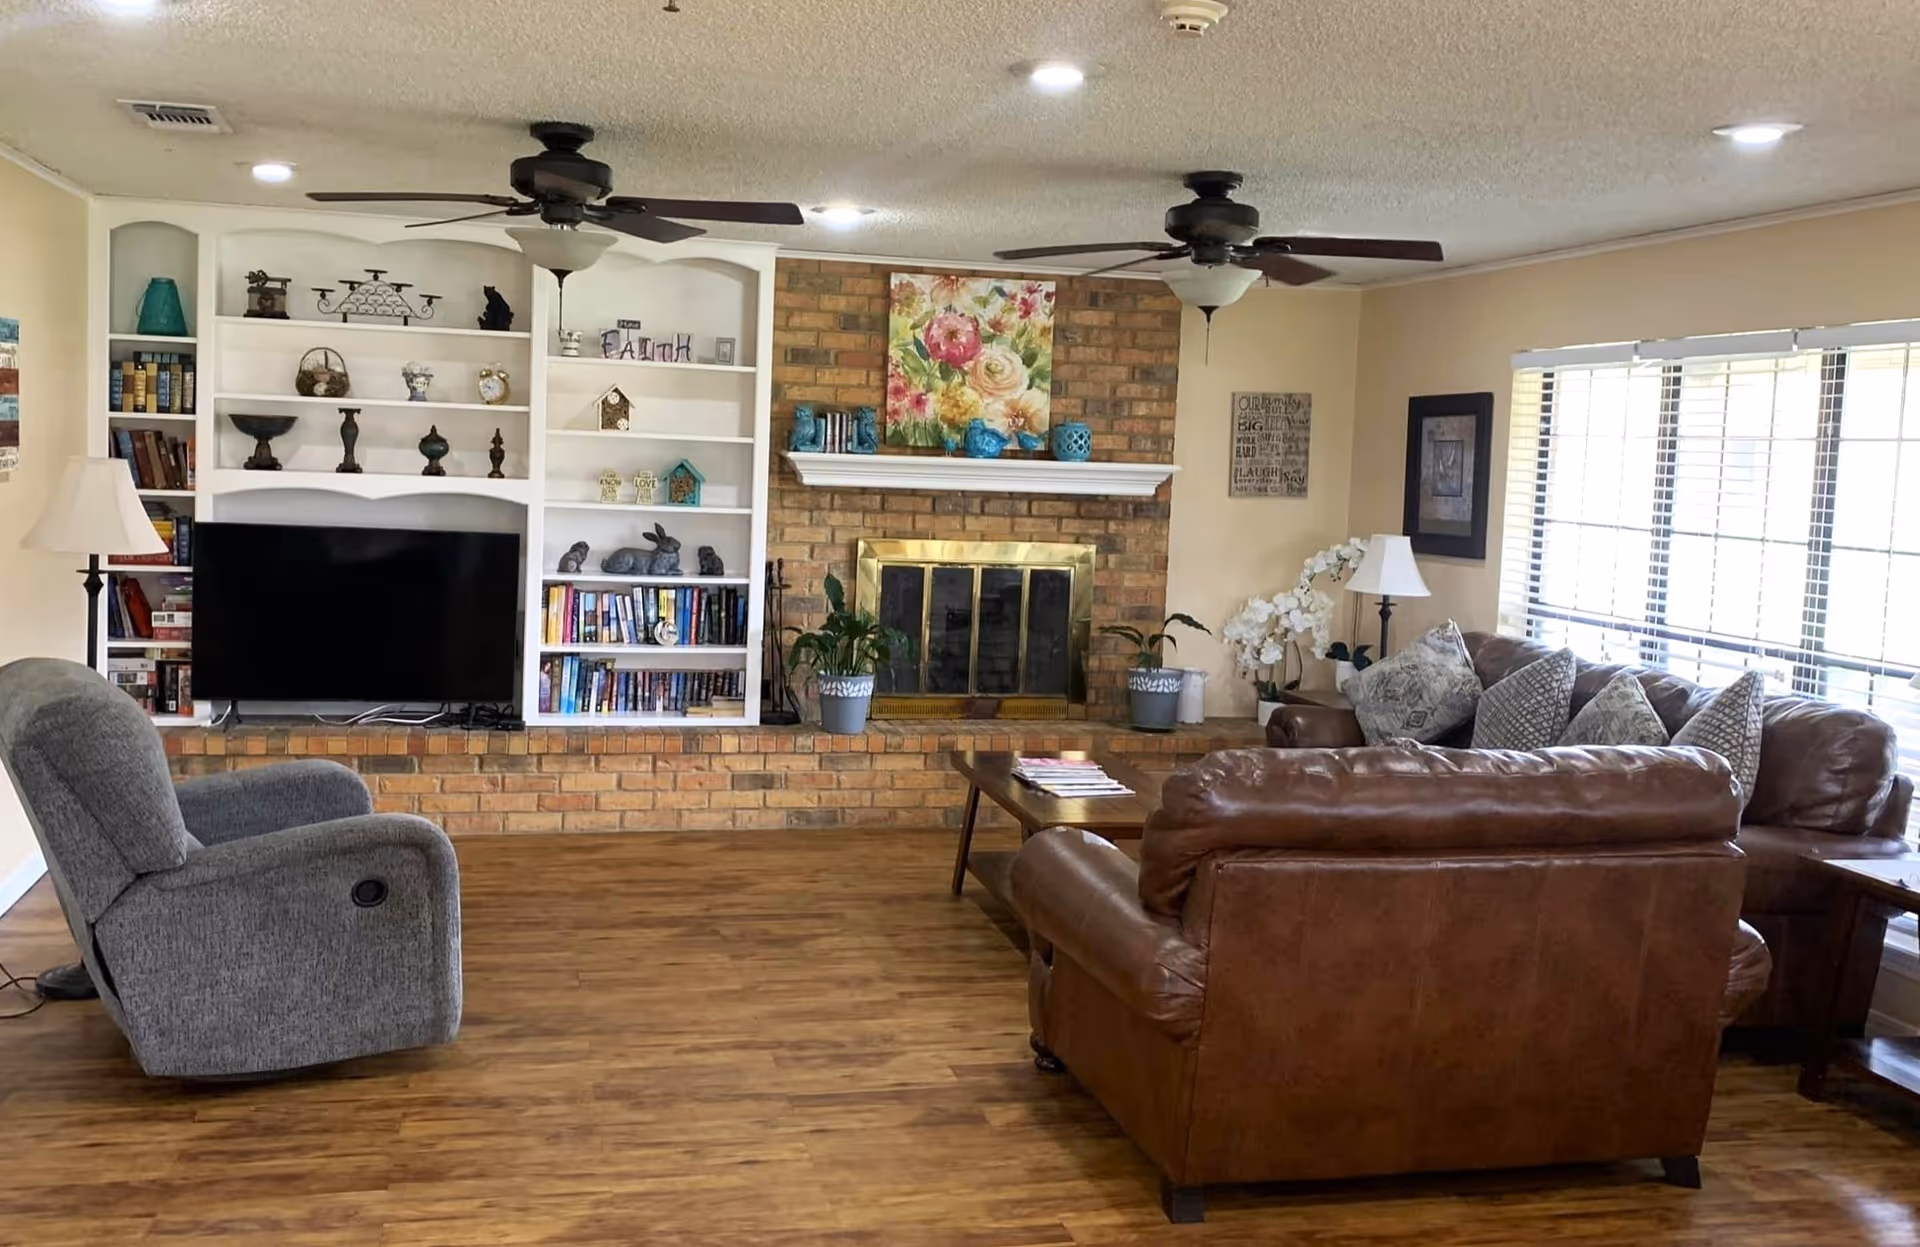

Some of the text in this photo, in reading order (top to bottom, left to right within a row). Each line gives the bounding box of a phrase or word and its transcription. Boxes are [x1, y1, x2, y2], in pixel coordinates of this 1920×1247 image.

[601, 329, 691, 362] FAITH
[1238, 396, 1261, 411] OUR
[1238, 421, 1263, 431] BIG
[1236, 446, 1257, 458] HARD
[1239, 467, 1278, 478] LAUGH
[1283, 471, 1305, 485] Say
[635, 479, 656, 488] LOVE
